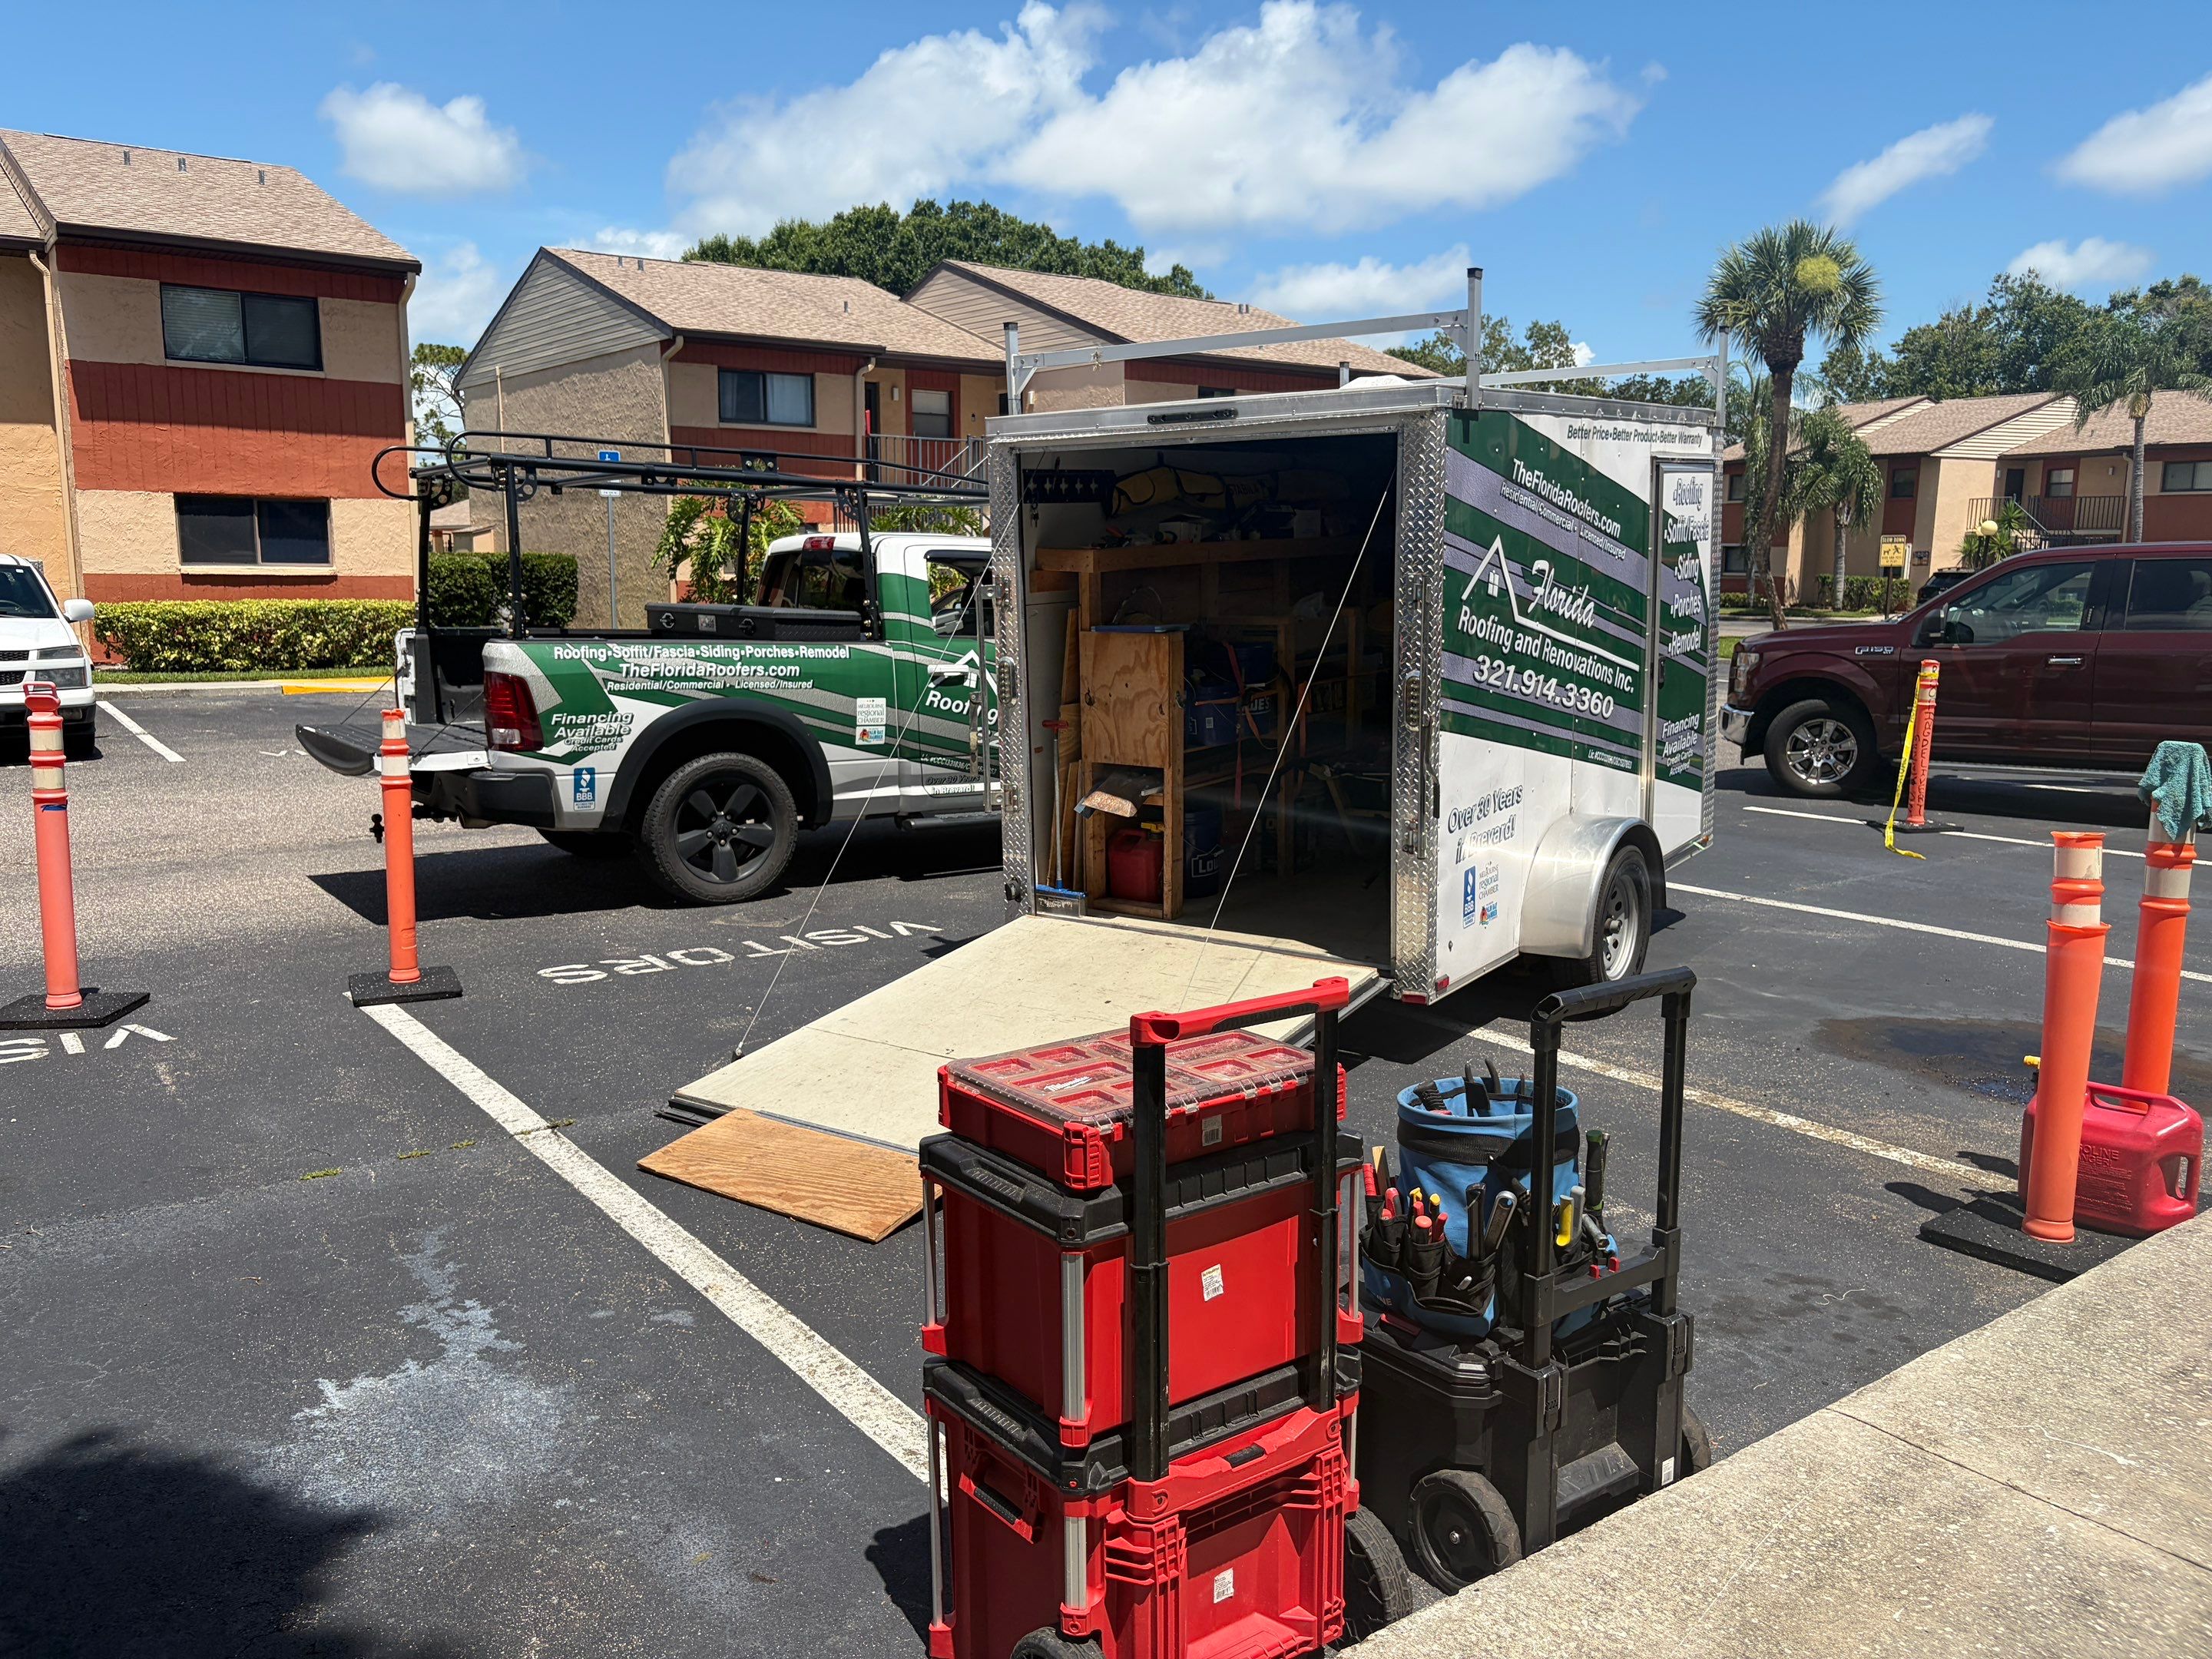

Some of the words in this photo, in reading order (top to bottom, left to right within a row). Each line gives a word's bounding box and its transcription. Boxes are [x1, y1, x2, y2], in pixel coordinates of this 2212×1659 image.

[1567, 425, 1591, 441] Better
[1592, 426, 1609, 441] Price
[1612, 428, 1632, 442] Better
[1633, 429, 1657, 443] Product
[1660, 431, 1677, 444] Better
[1678, 432, 1703, 448] Warranty
[1512, 458, 1621, 538] TheFloridaRoofers.com
[1500, 482, 1574, 531] Residential/Commercial
[1580, 525, 1626, 560] Licensed/Insured
[1677, 552, 1700, 584] Siding
[1527, 559, 1594, 629] Florida
[1674, 590, 1701, 619] Porches
[1458, 604, 1514, 654] Roofing
[1515, 632, 1542, 658] and
[1542, 637, 1613, 686] Renovations
[1614, 666, 1634, 694] Inc.
[1671, 624, 1701, 657] Remodel
[619, 662, 800, 677] TheFloridaRoofers.com
[607, 679, 724, 691] Residential/Commercial
[735, 679, 813, 690] Licensed/Insured
[1473, 654, 1614, 719] 321.914.3360
[551, 711, 634, 726] Financing
[858, 707, 884, 717] regional
[926, 690, 998, 725] Roofg
[555, 724, 632, 738] Available
[1662, 713, 1700, 739] Financing
[564, 737, 593, 745] Credit
[571, 743, 617, 753] Accepted
[1662, 730, 1697, 758] Available
[1667, 753, 1681, 767] Credit
[1681, 749, 1694, 762] Cards
[1669, 760, 1690, 777] Accepted
[926, 776, 946, 785] Over
[946, 775, 958, 783] 30
[959, 774, 981, 783] Years
[576, 792, 593, 801] BBB
[1448, 803, 1477, 834] Over
[1477, 793, 1491, 821] 30
[1493, 784, 1523, 814] Years
[1468, 813, 1516, 858] Brevard!
[1479, 884, 1498, 899] CHAMBER
[1464, 900, 1475, 914] BBB
[537, 920, 945, 985] VISITORS
[2080, 1144, 2119, 1160] OLINE
